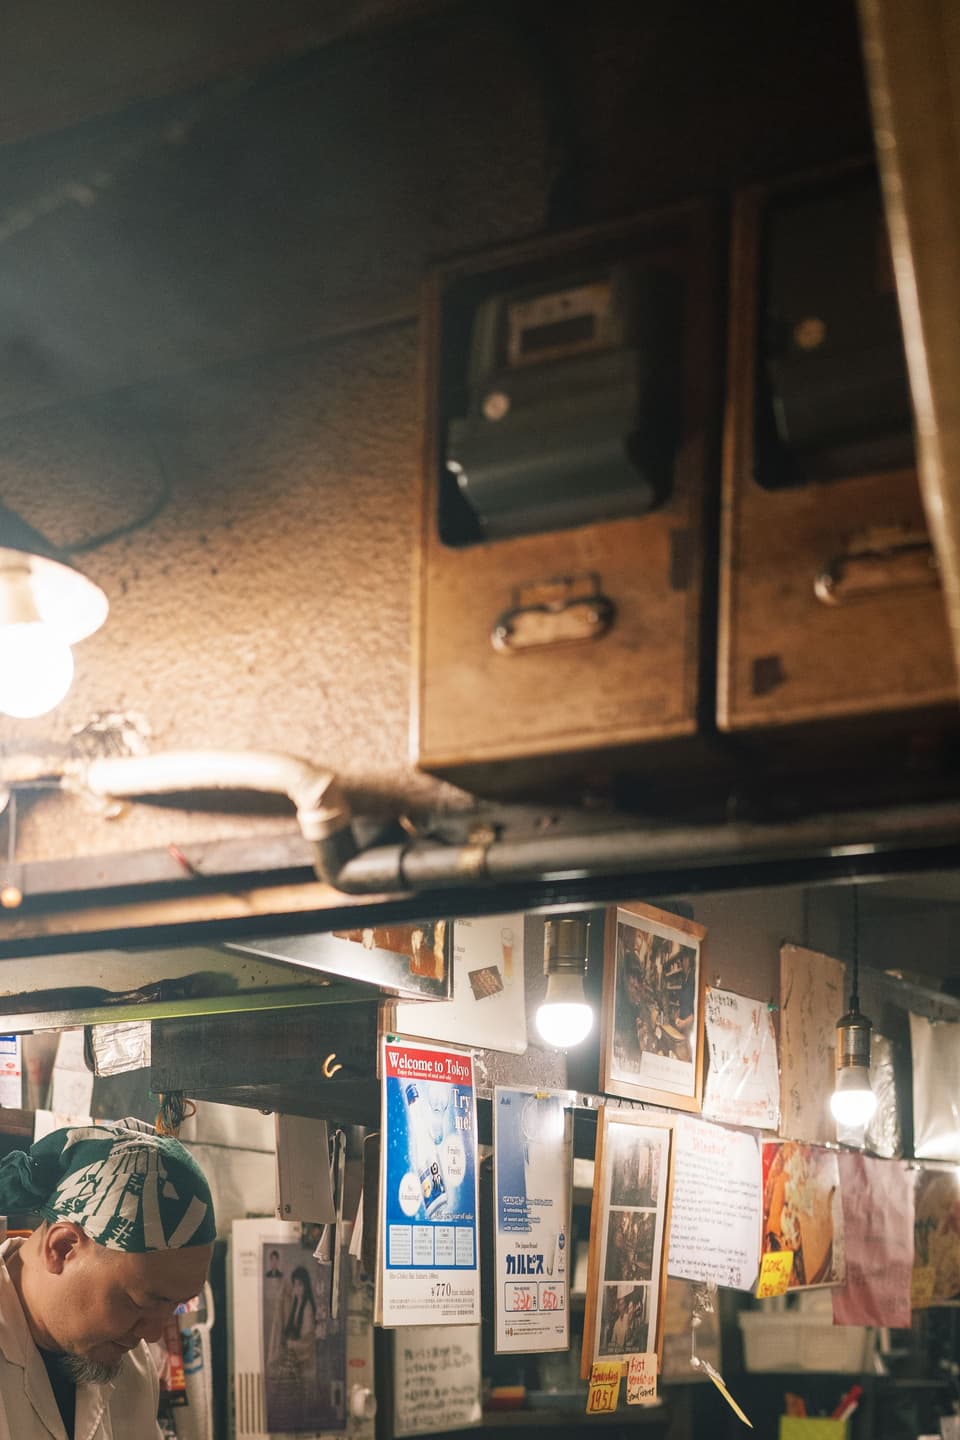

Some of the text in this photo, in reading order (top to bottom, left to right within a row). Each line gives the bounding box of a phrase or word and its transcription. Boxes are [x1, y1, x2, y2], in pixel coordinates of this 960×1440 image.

[388, 1051, 470, 1081] Welcome to Tokyo
[452, 1088, 471, 1113] Try
[455, 1115, 472, 1132] me!
[506, 1254, 544, 1275] カルピス
[590, 1388, 614, 1410] 1951
